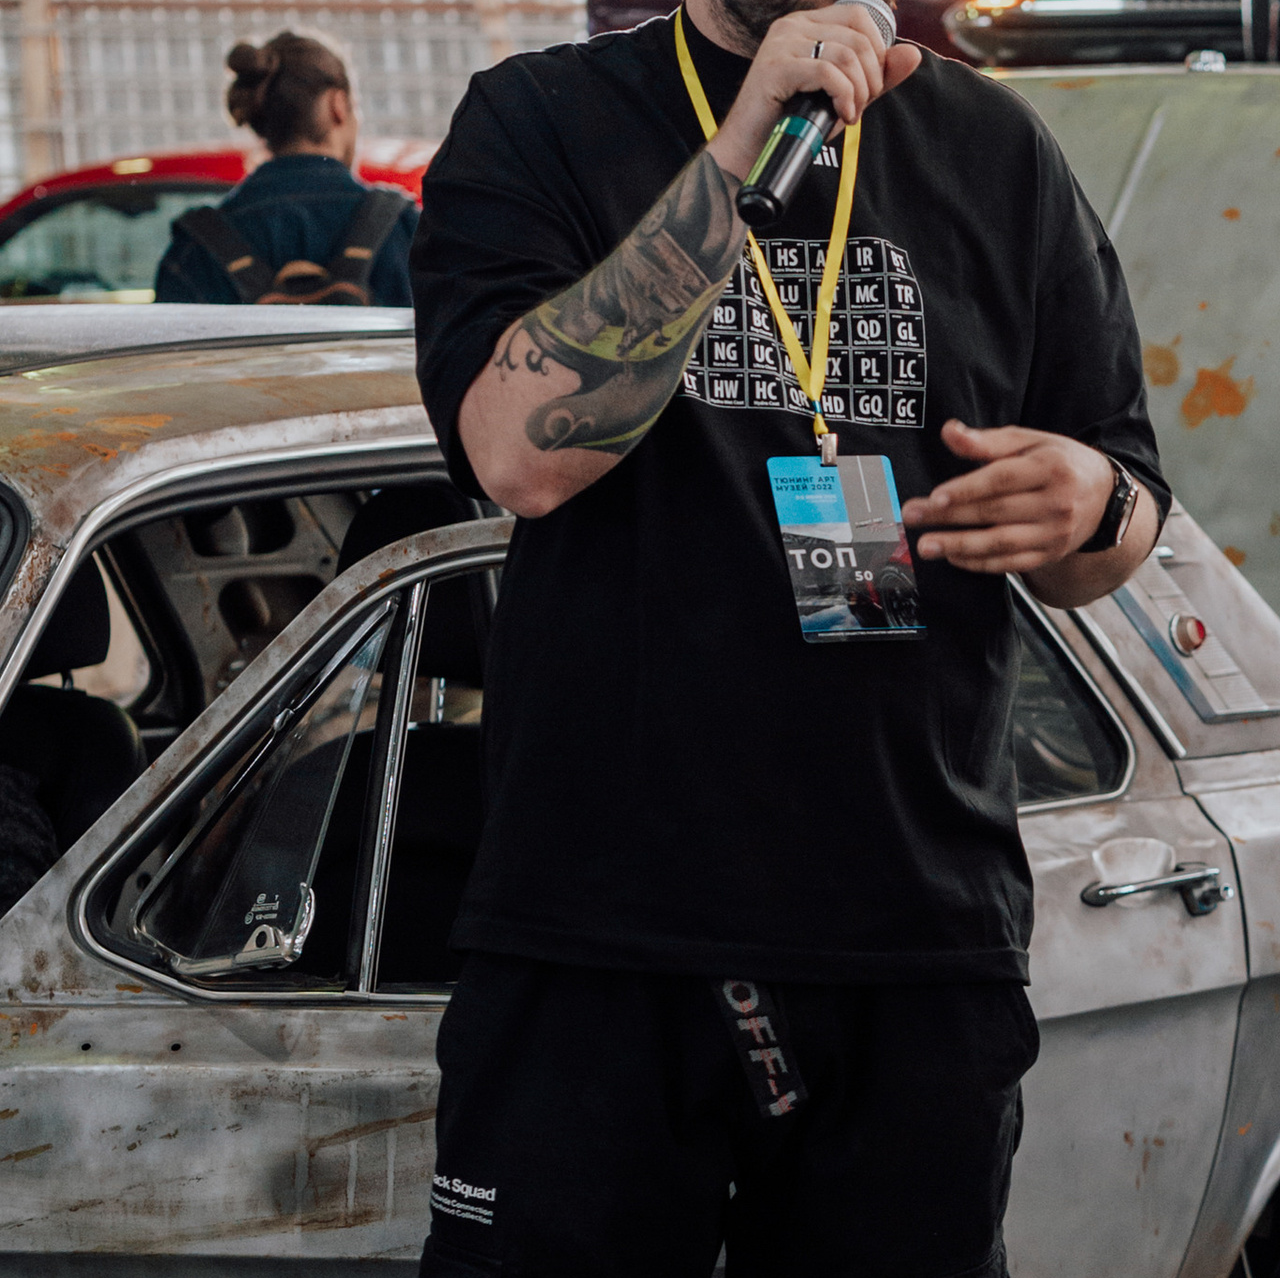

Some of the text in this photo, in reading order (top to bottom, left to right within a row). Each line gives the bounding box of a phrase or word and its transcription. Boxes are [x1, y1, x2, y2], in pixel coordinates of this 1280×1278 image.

[777, 248, 799, 267] HS
[856, 247, 874, 266] IR
[890, 250, 906, 270] BT
[780, 285, 799, 303] LU
[855, 284, 879, 303] MC
[895, 284, 915, 304] TR
[713, 306, 736, 324] RD
[752, 309, 770, 330] BC
[856, 319, 881, 340] QD
[897, 322, 917, 341] GL
[714, 342, 737, 361] NG
[754, 344, 774, 365] UC
[861, 358, 881, 377] PL
[899, 359, 917, 378] LC
[714, 380, 739, 399] HW
[755, 381, 777, 401] HC
[789, 387, 810, 409] QR
[822, 396, 845, 414] HD
[859, 395, 883, 417] GQ
[896, 399, 916, 418] GC
[774, 476, 814, 484] ТЮНИНГ
[776, 482, 832, 491] МУЗЕЙ 2022
[788, 547, 857, 569] ТОП
[855, 570, 873, 582] 50
[451, 1178, 497, 1202] Squad
